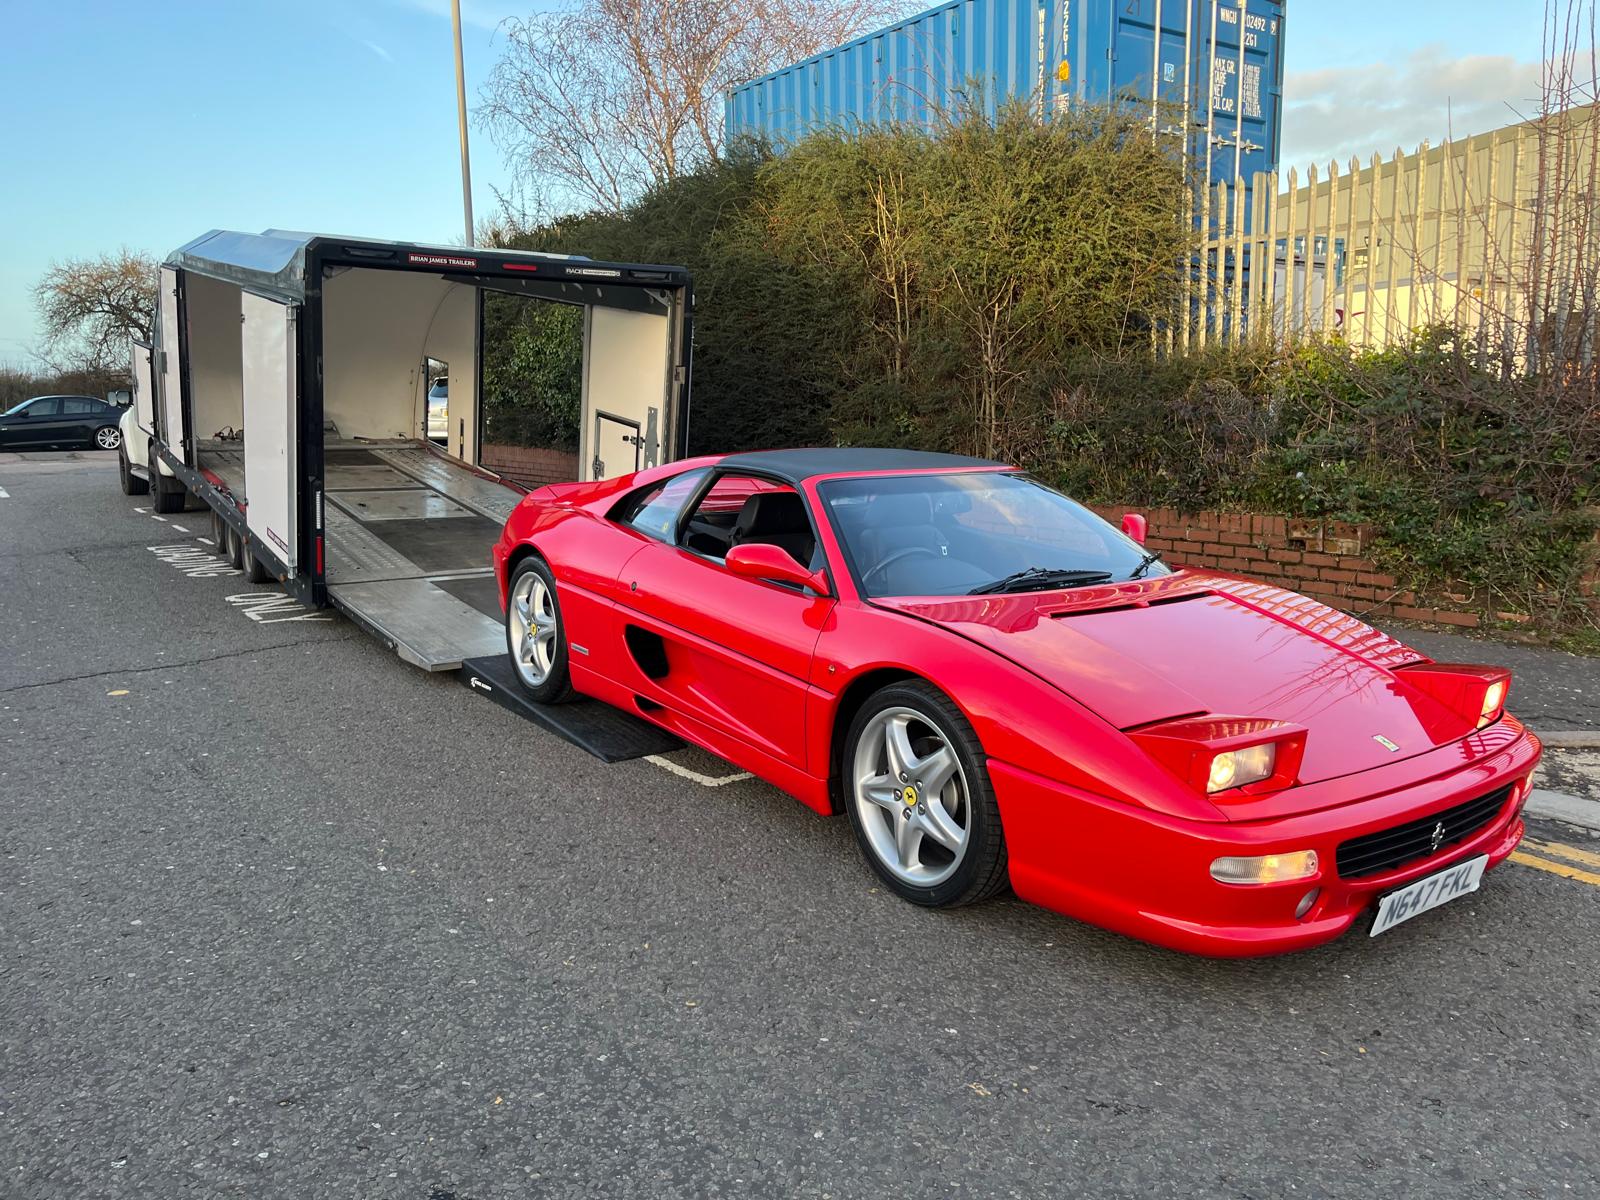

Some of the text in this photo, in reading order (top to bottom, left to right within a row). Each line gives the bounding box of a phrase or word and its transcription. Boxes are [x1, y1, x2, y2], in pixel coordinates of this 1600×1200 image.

[1246, 15, 1266, 31] 02492
[410, 255, 428, 263] BRIAN
[429, 257, 447, 265] JAMES
[224, 592, 333, 623] ONLY
[1382, 865, 1473, 927] N647 FKL
